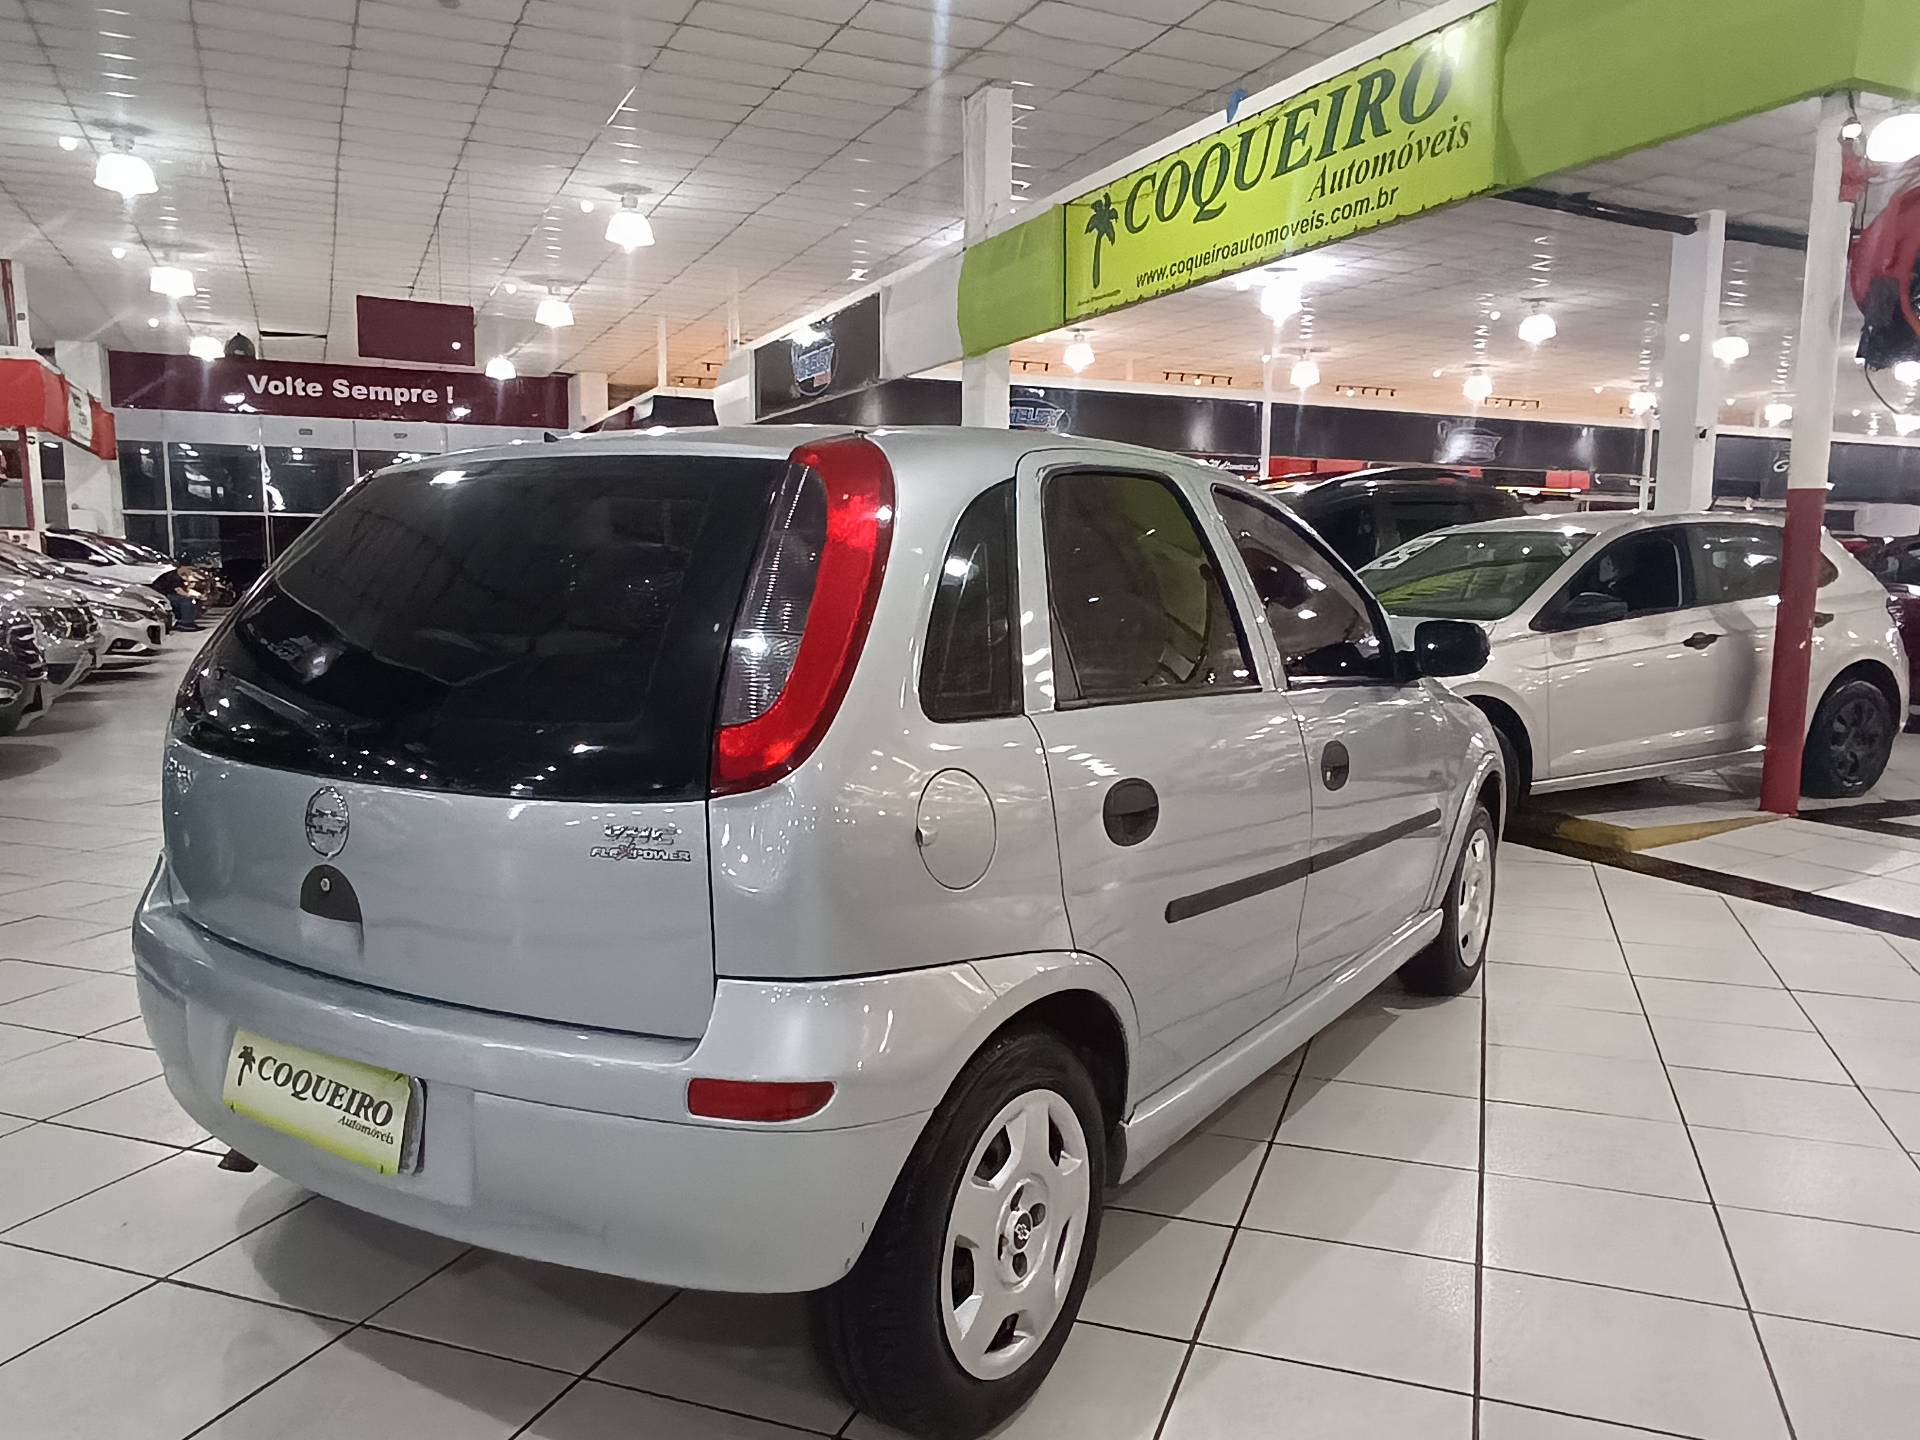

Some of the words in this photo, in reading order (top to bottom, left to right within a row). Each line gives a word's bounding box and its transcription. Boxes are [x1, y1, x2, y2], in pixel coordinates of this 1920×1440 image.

[1124, 50, 1453, 234] COQUEIRO
[1307, 114, 1472, 203] Automóveis
[1136, 183, 1400, 288] www.coqueiroautomoveis.com.br
[247, 374, 323, 397] Volte
[332, 378, 438, 406] Sempre
[258, 1056, 394, 1127] COQUEIRO
